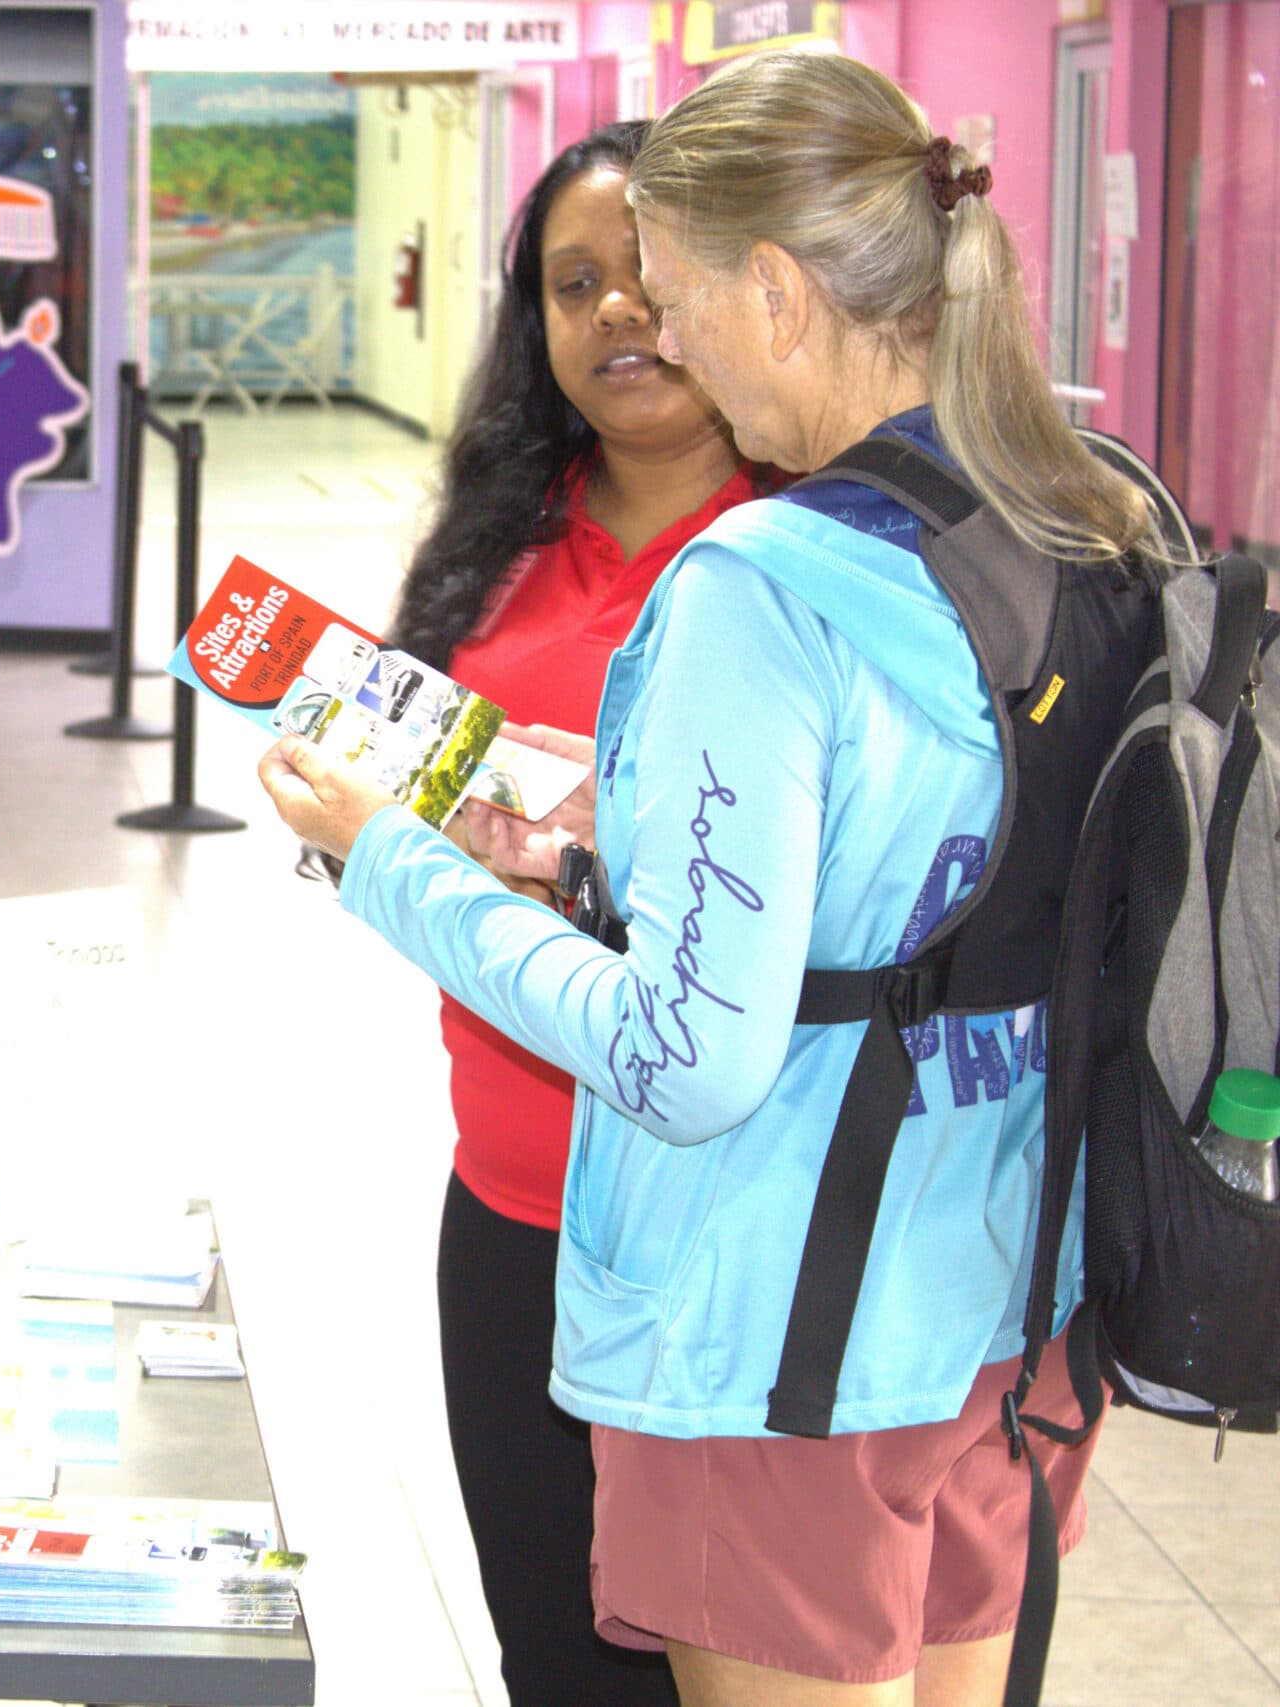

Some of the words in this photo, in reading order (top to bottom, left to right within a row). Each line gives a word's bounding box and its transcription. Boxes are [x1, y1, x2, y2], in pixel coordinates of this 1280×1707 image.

[503, 20, 563, 44] ARTE
[195, 612, 243, 663] Sites
[229, 592, 256, 613] &
[209, 585, 289, 690] Attractions
[250, 662, 275, 692] PORT
[269, 647, 284, 664] OF
[279, 614, 306, 649] SPAIN
[273, 638, 312, 686] TRINIDAD
